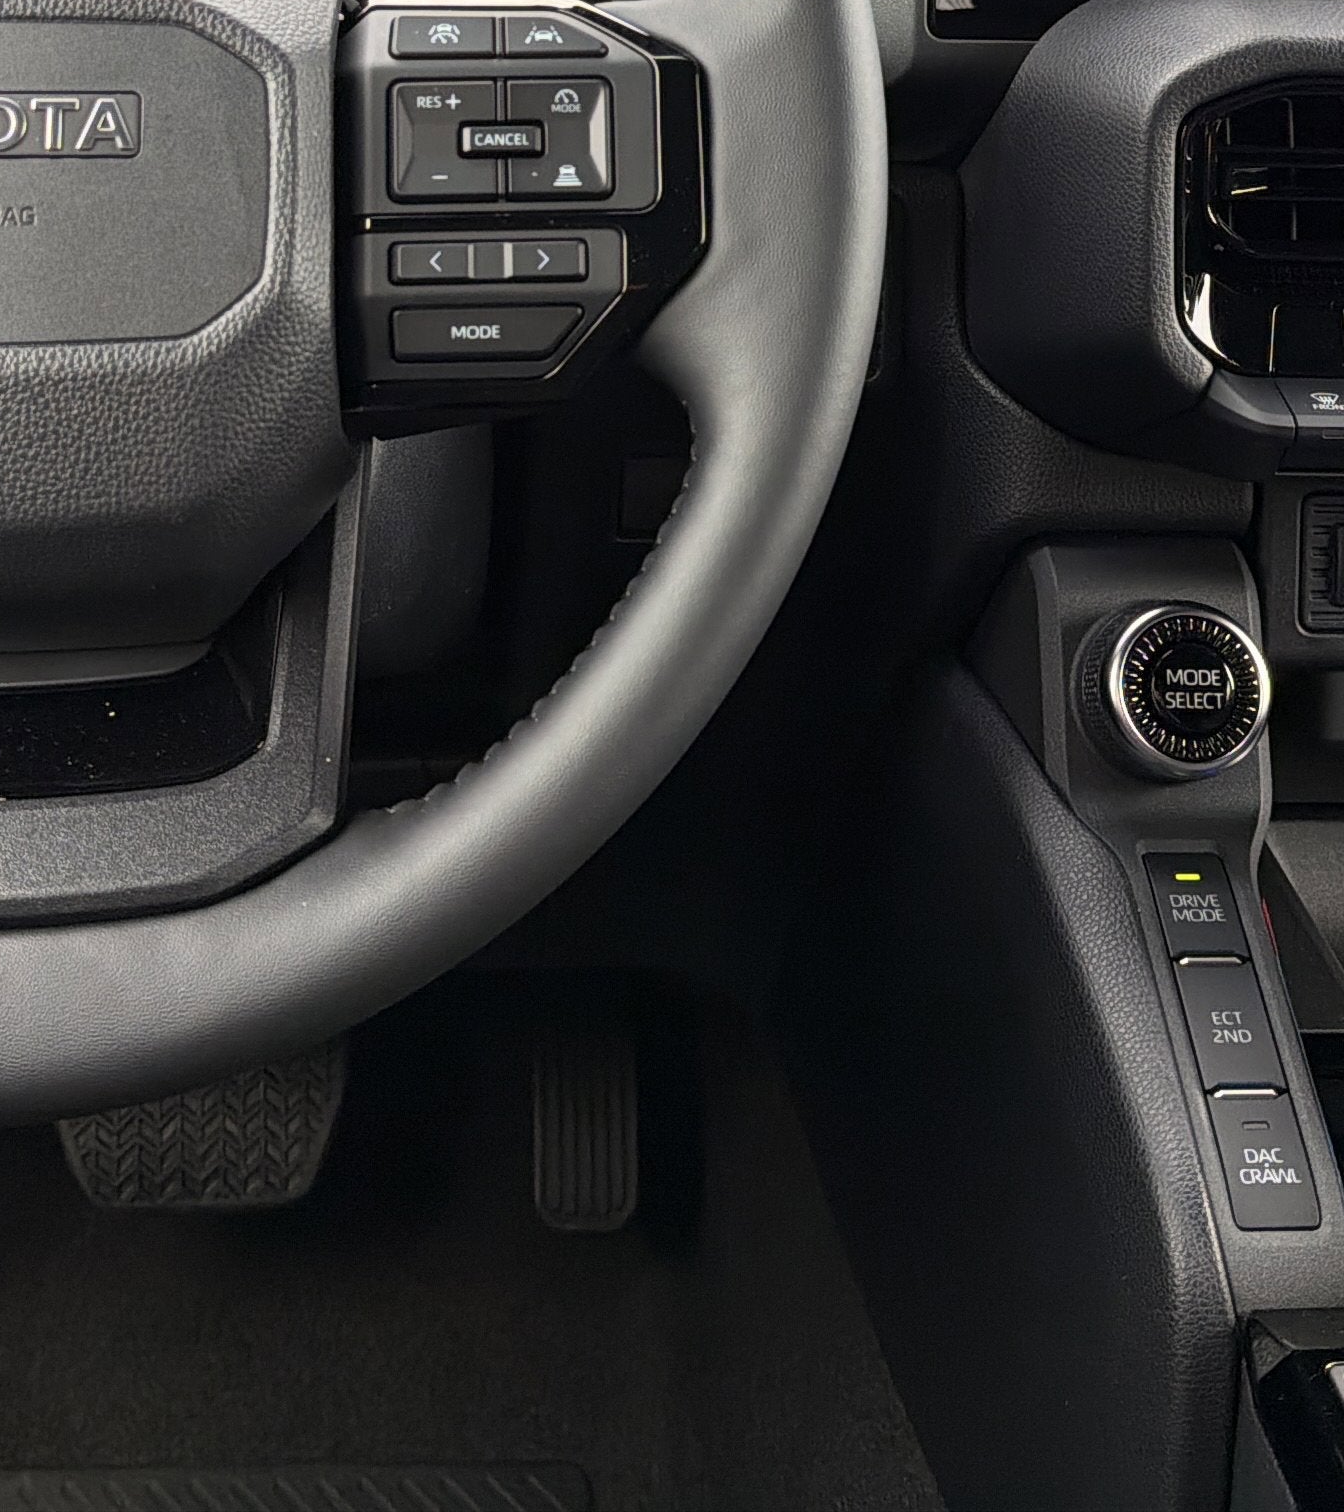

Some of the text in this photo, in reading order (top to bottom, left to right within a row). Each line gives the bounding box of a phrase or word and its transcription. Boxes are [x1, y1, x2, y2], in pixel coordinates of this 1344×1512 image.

[416, 96, 442, 109] RES
[551, 103, 582, 113] MODE
[474, 132, 529, 147] CANCEL
[451, 325, 501, 339] MODE
[1166, 668, 1221, 687] MODE
[1165, 692, 1224, 710] SELECT
[1169, 894, 1220, 909] DRIVE
[1172, 908, 1226, 922] MODE
[1211, 1011, 1242, 1025] ECT
[1212, 1029, 1252, 1044] 2ND
[1243, 1148, 1284, 1164] DAC
[1239, 1169, 1302, 1185] CRAWL
